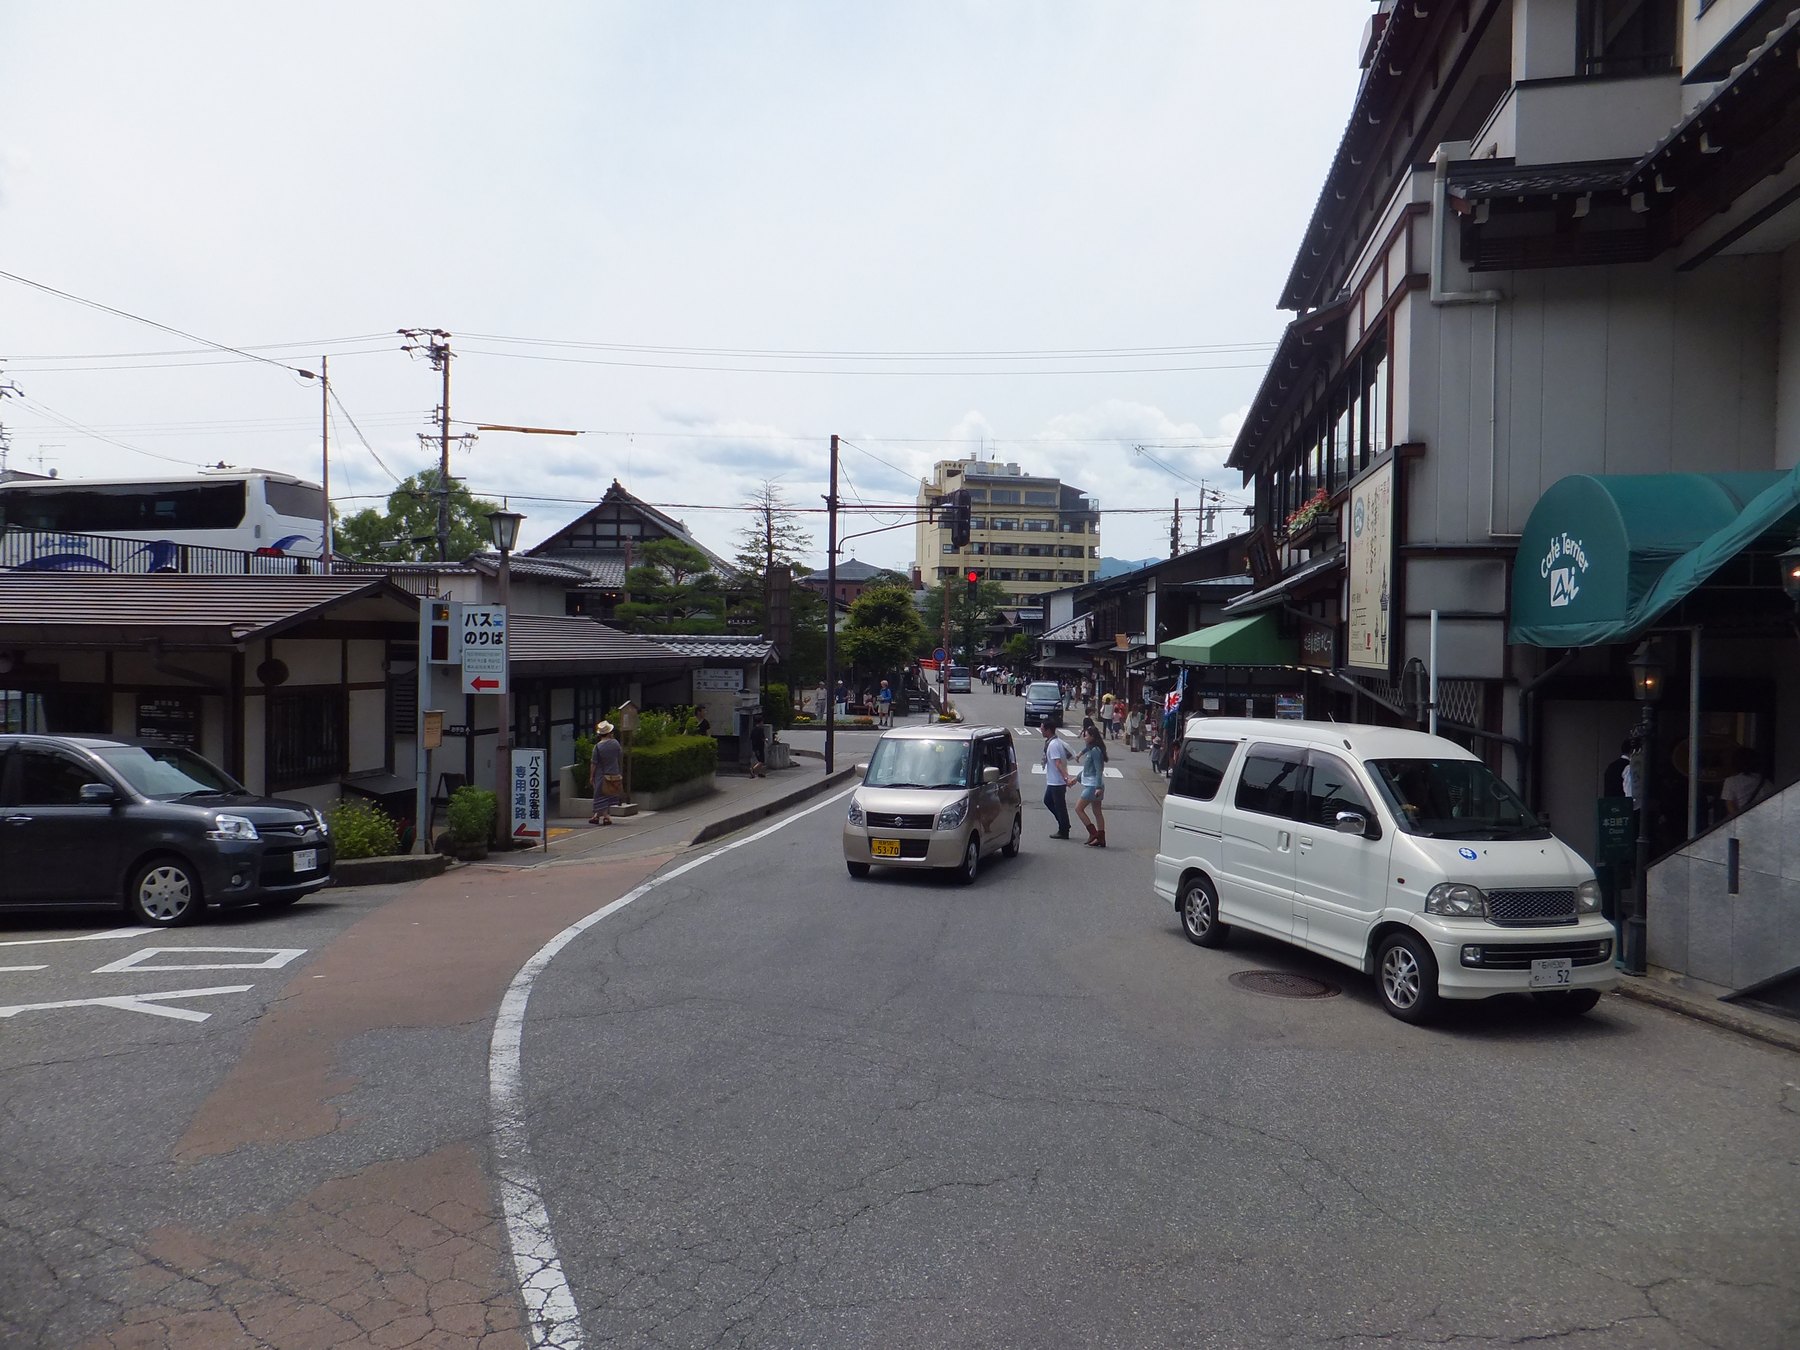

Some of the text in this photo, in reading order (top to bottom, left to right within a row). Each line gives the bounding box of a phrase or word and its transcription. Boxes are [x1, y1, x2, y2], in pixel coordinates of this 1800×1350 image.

[1561, 532, 1589, 573] Terrier
[464, 631, 504, 645] のりば
[465, 613, 493, 627] バス
[515, 766, 527, 819] 専用通路
[529, 755, 541, 819] バスのお客様
